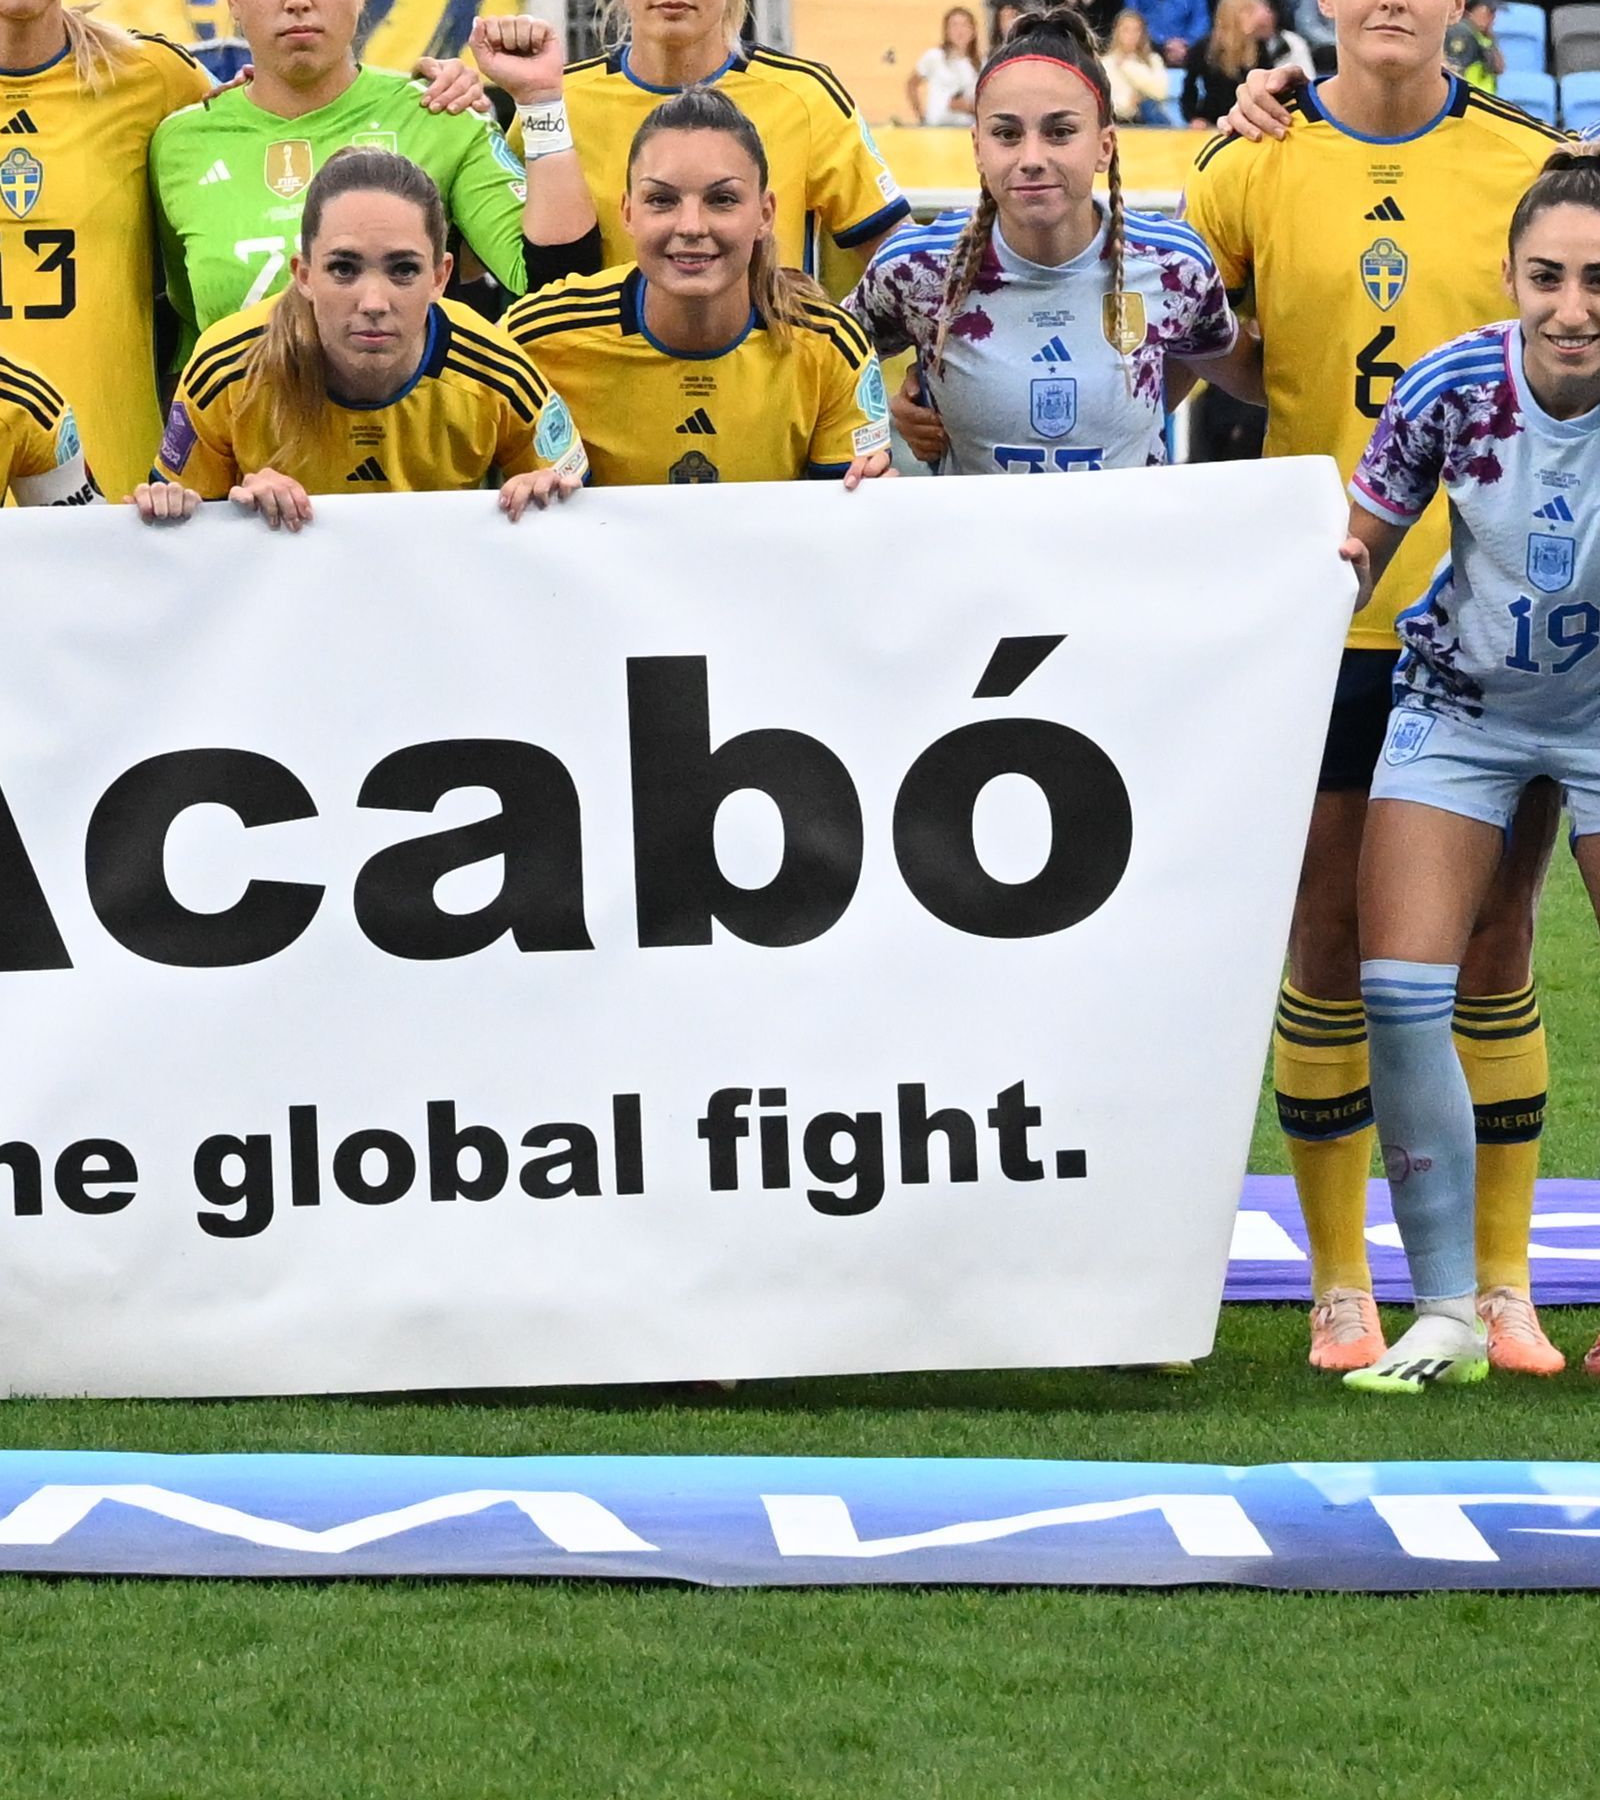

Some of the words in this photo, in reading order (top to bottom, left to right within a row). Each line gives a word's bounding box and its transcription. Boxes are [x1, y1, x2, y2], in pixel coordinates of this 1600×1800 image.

[1354, 325, 1406, 419] 6
[194, 1093, 644, 1239] global
[698, 1080, 1087, 1217] fight.
